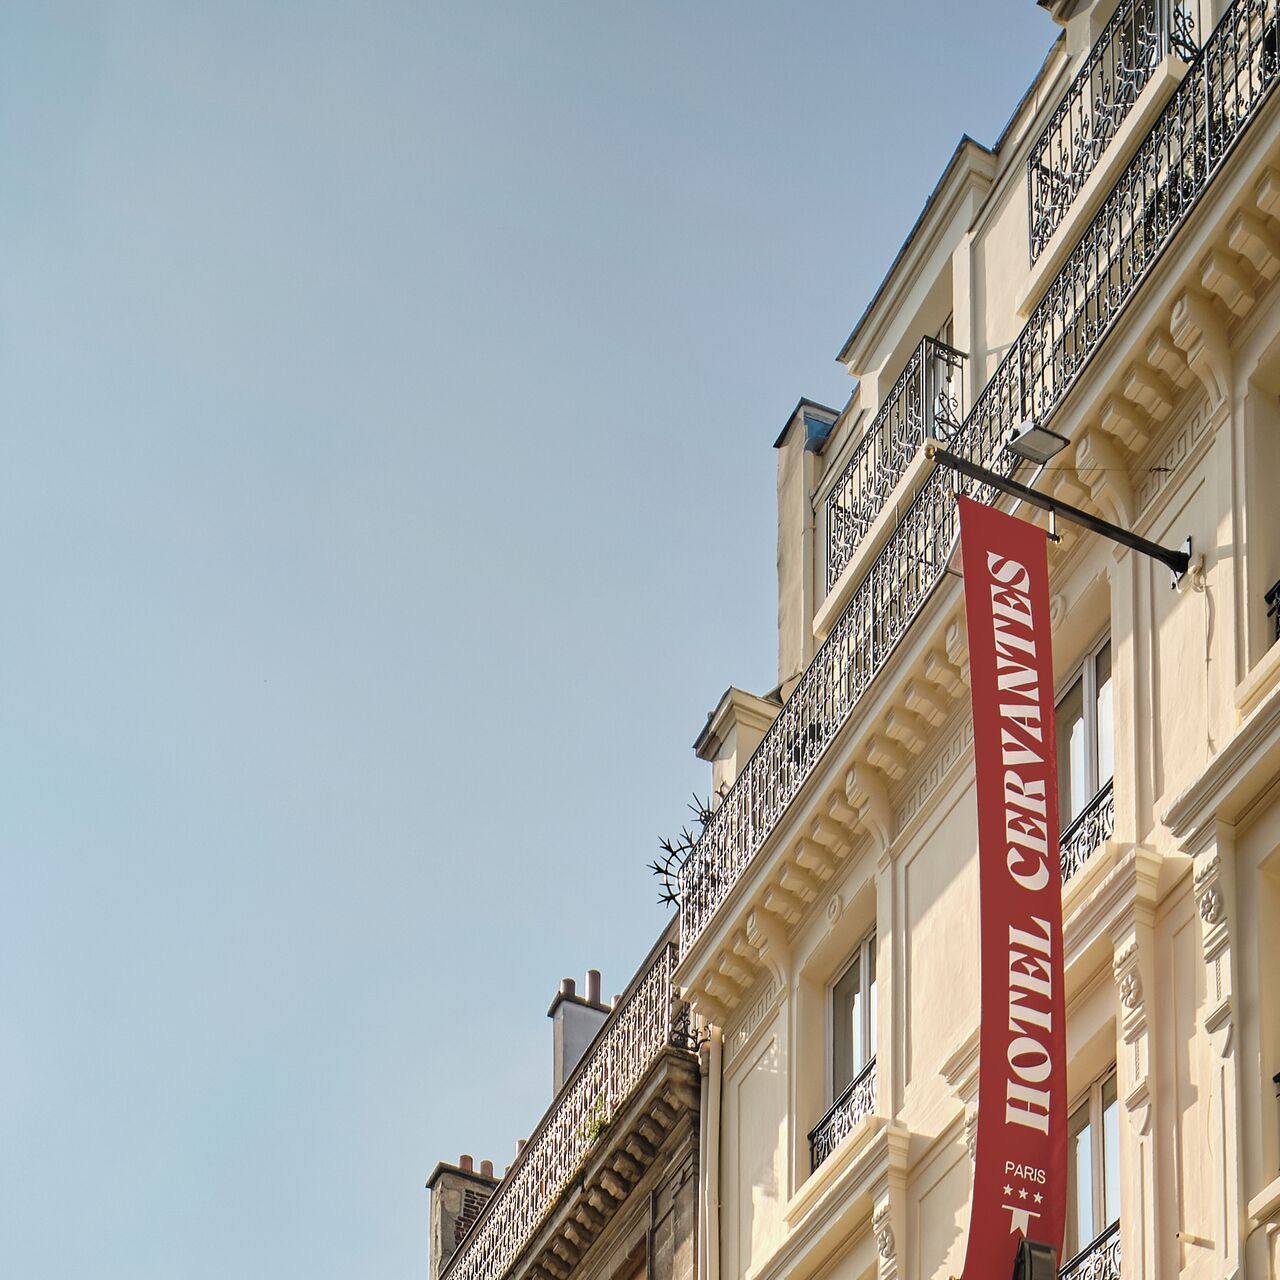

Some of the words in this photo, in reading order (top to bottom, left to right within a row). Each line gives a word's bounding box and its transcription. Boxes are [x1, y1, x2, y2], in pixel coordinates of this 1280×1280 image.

[986, 550, 1050, 891] CERVANTES
[1005, 915, 1052, 1136] HOTEL
[1004, 1160, 1046, 1185] PARIS
